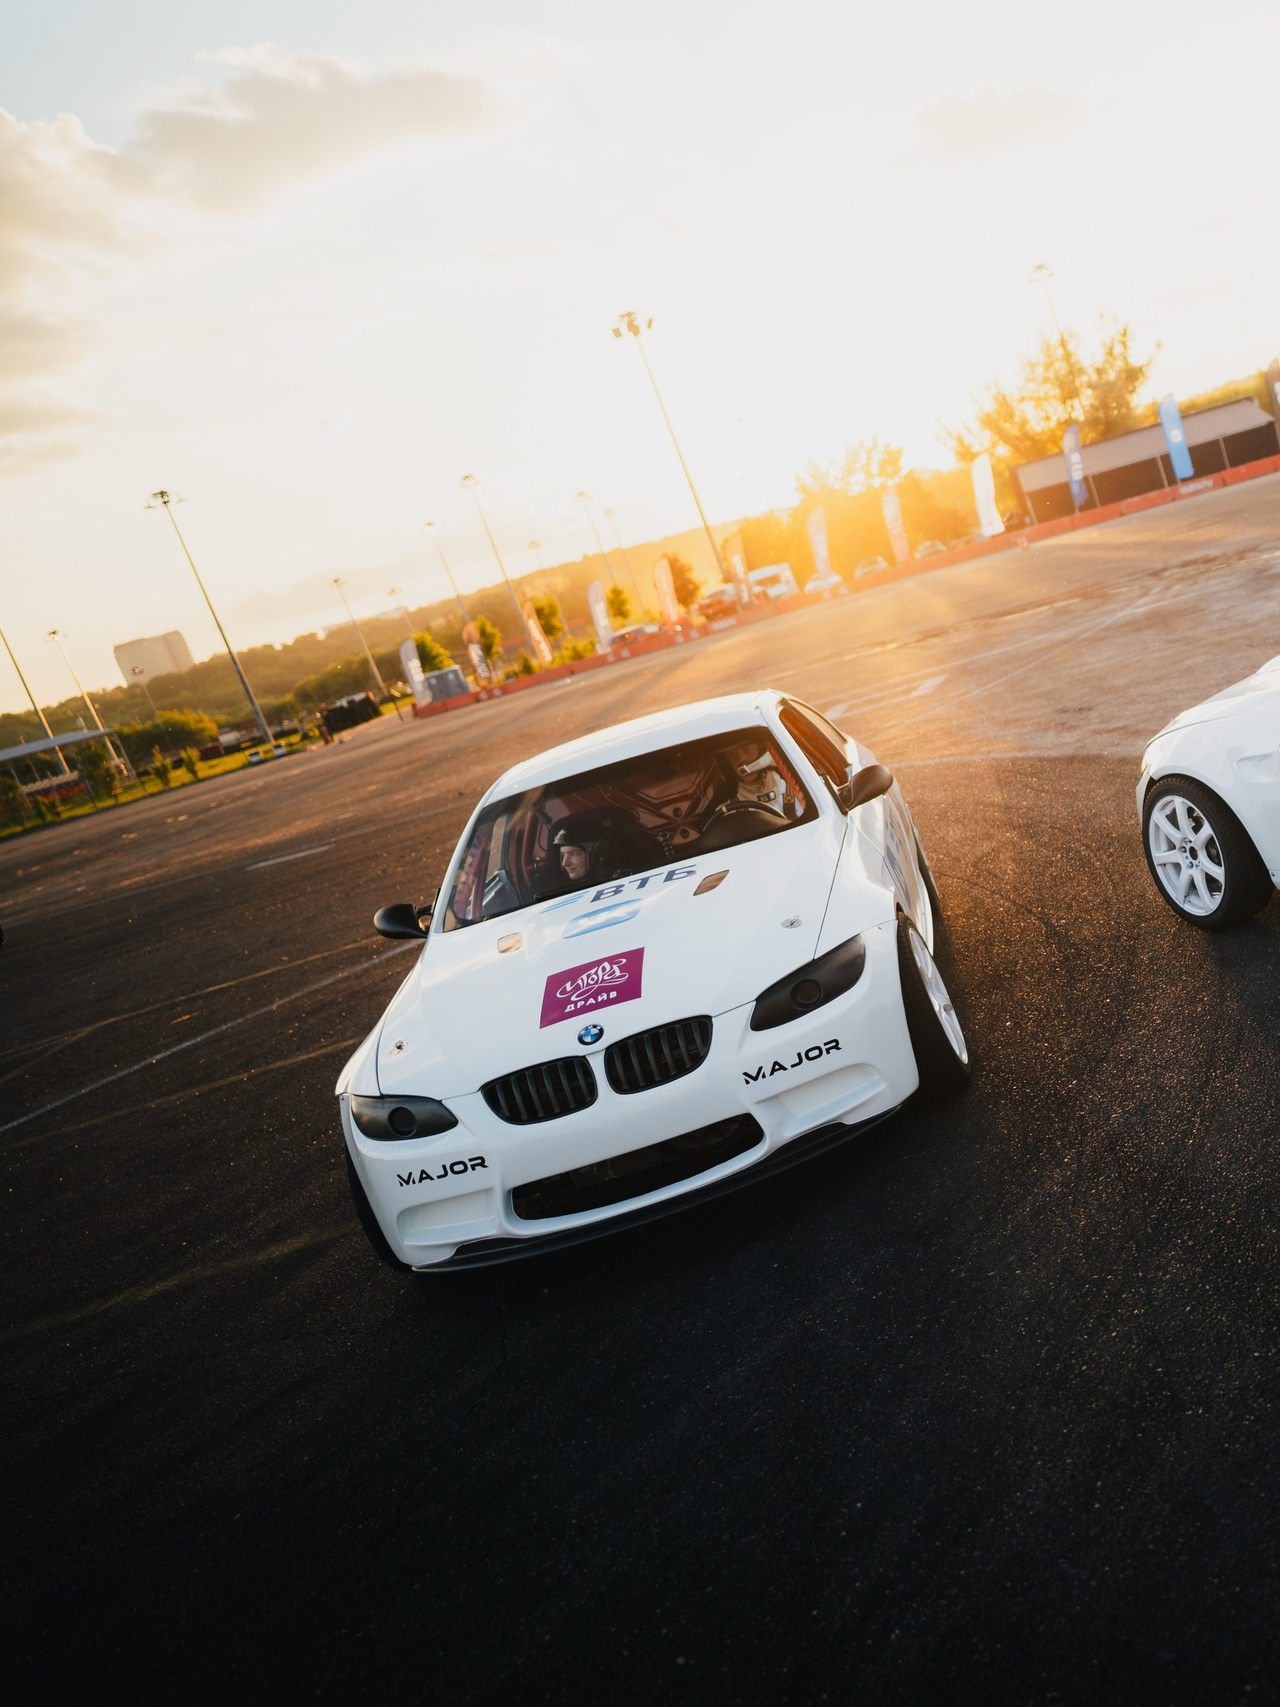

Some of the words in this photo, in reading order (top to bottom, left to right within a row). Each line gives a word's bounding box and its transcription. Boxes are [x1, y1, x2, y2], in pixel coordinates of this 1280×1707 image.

[589, 863, 697, 904] ВТБ
[564, 991, 618, 1013] ДРАЙВ
[743, 1038, 842, 1085] MAJOR
[397, 1155, 489, 1188] MAJOR
